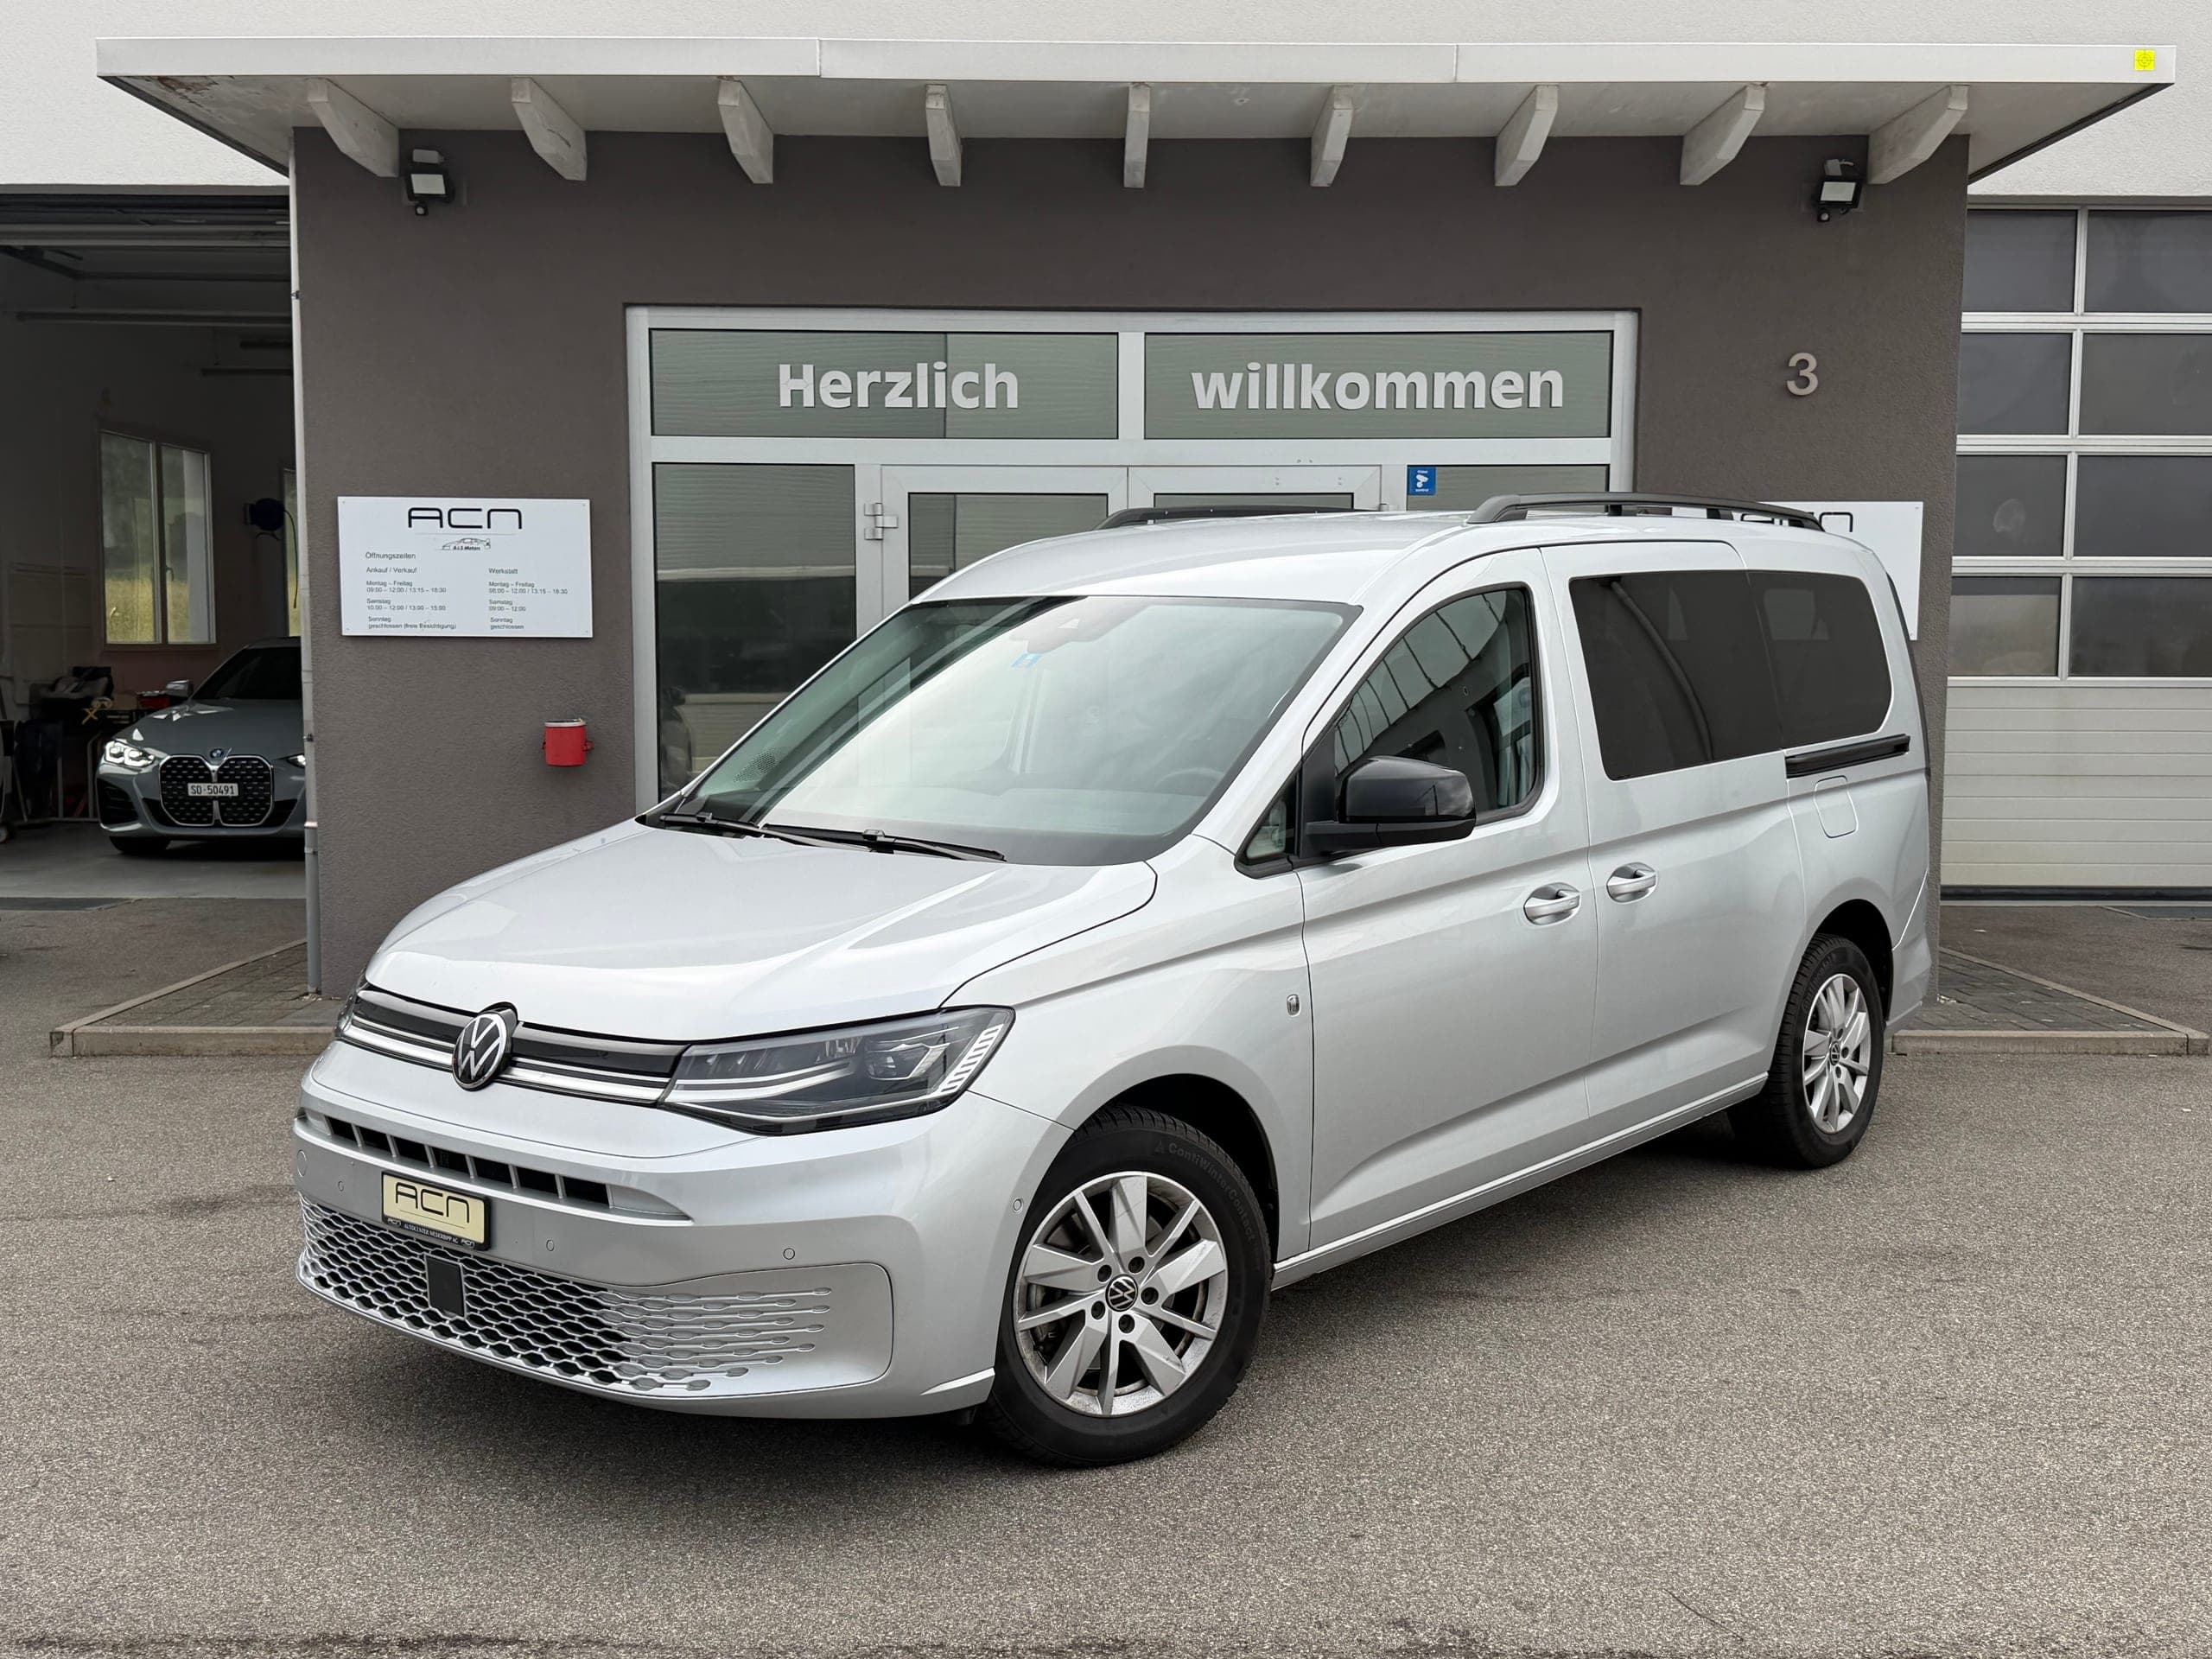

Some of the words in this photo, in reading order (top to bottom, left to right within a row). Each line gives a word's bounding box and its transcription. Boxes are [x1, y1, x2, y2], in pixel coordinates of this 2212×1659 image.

[779, 361, 1019, 409] Herzlich
[1192, 361, 1564, 410] willkommen
[1786, 352, 1819, 397] 3
[408, 507, 522, 529] ACN
[396, 1182, 470, 1224] ACN
